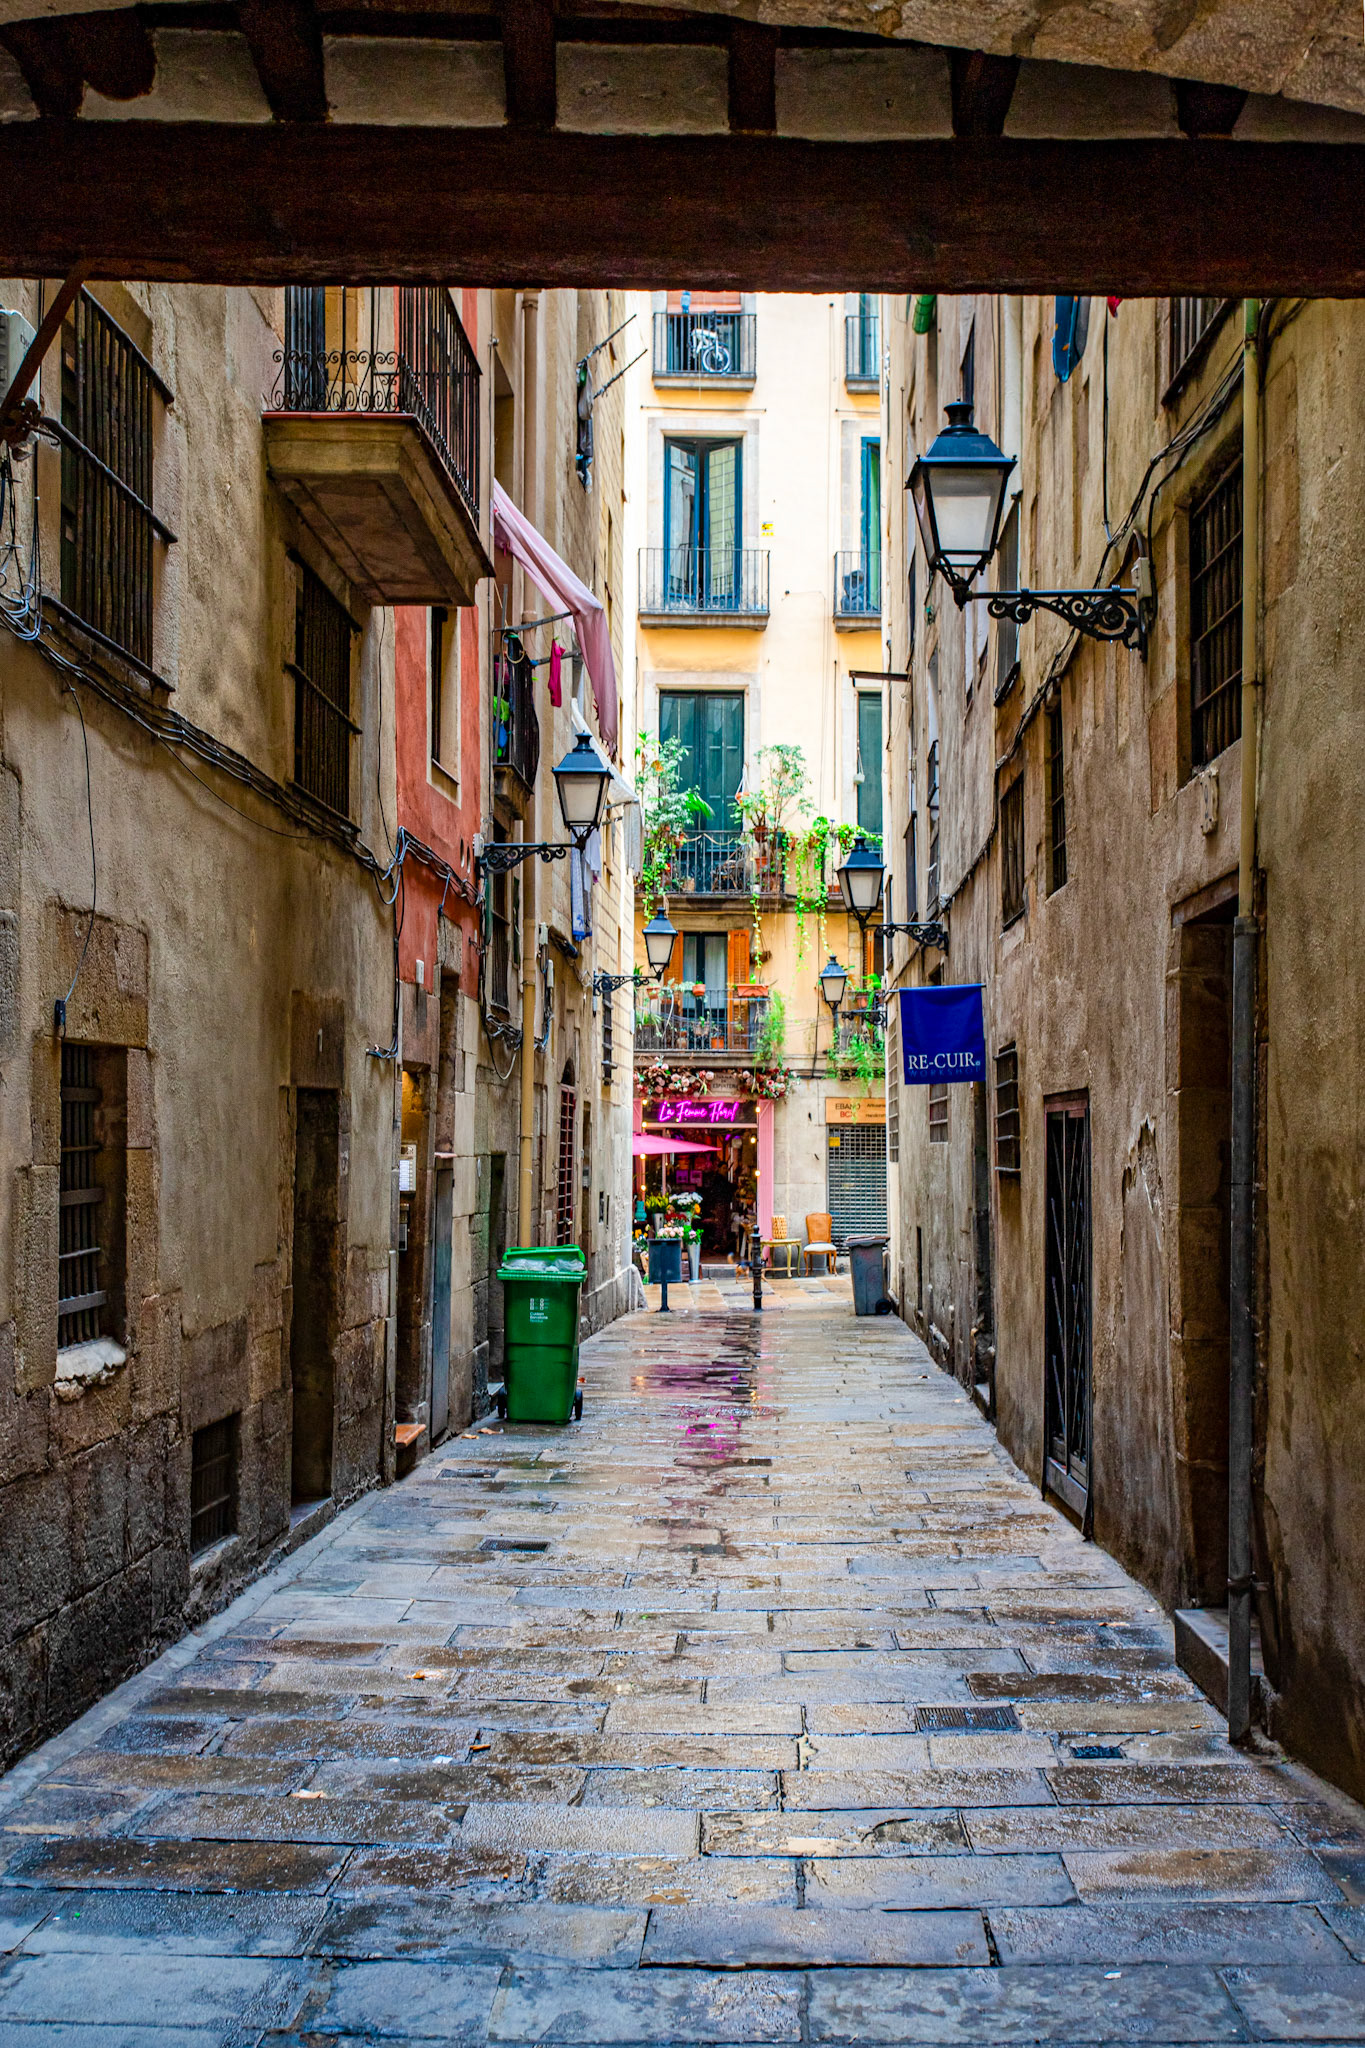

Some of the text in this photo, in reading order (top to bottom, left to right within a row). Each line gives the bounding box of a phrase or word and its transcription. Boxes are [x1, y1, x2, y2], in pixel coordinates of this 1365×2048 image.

[658, 1100, 739, 1123] La Femme Floral
